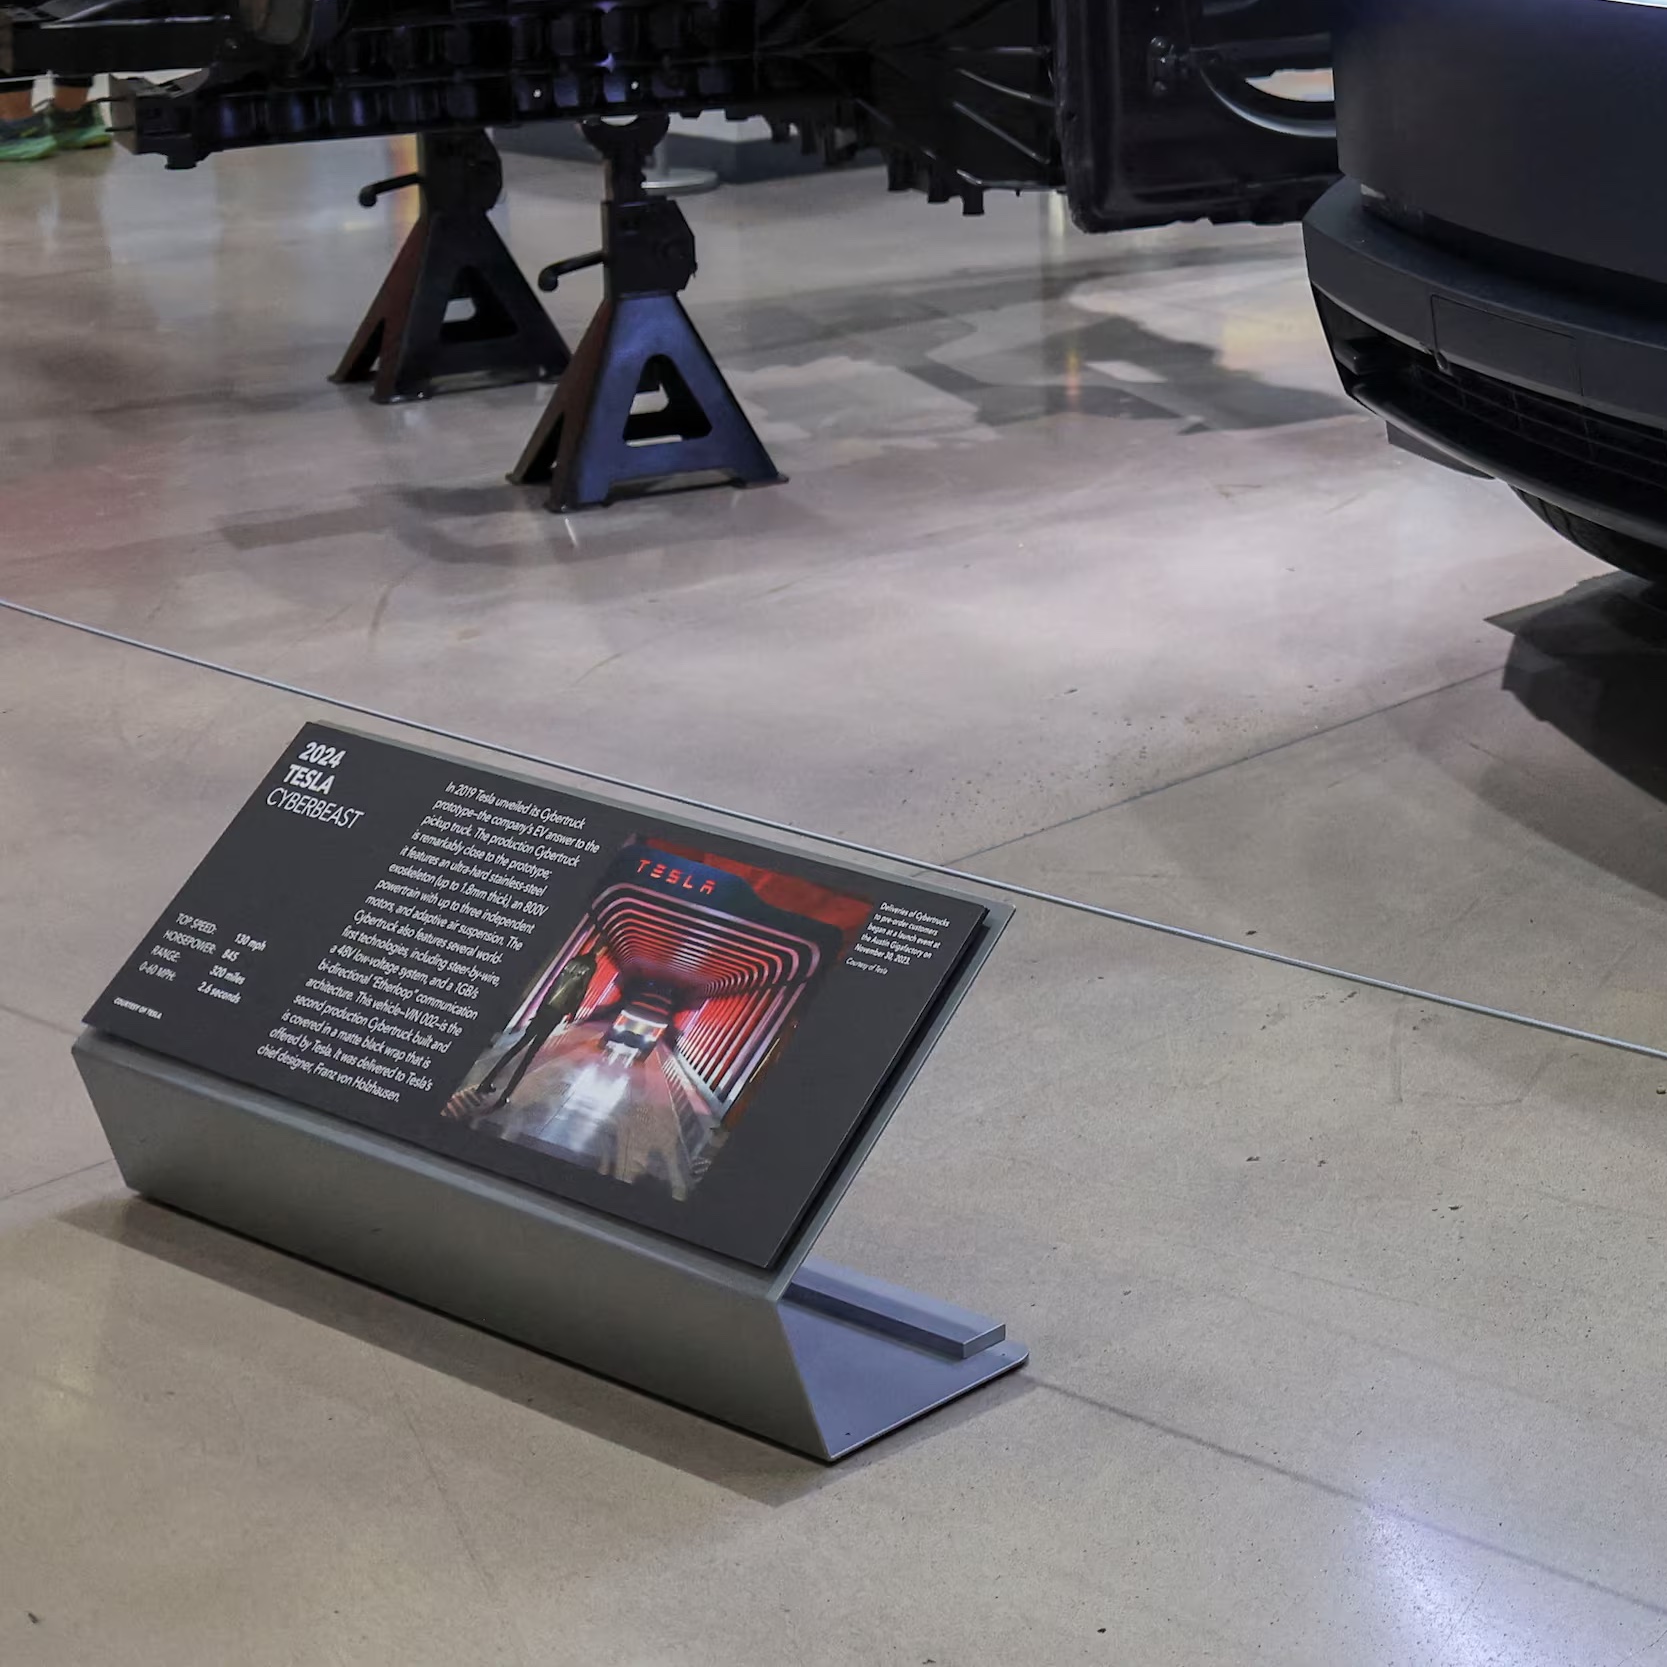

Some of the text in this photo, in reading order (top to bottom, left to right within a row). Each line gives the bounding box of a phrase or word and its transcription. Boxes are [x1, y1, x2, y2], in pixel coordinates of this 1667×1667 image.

[283, 764, 335, 795] TESLA
[298, 741, 346, 769] 2024
[267, 787, 365, 829] CYBERBEAST
[445, 781, 586, 830] In 2019 Tesla unveiled its Cybertruck
[411, 829, 553, 880] is remarkably close to the prototype;
[420, 814, 580, 867] pickup truck. The production Cybertruck
[532, 825, 550, 838] EV
[545, 831, 577, 846] answer
[574, 838, 585, 849] to
[584, 839, 600, 853] the
[388, 864, 549, 917] exoskeleton (up to 1.8mm thick), an 800V
[399, 845, 548, 897] it features an ultra-hard stainless-steel
[636, 859, 716, 895] TESLA
[365, 896, 523, 951] motors, and adaptive air suspension. The
[374, 879, 535, 934] powertrain with up to three independent
[341, 925, 500, 987] first technologies, including steer-by-wire,
[354, 909, 504, 964] Cybertruck also features several world-
[317, 958, 374, 985] bi-directional
[415, 993, 478, 1020] communication
[329, 944, 479, 999] a 48V low-voltage system, and a 1GB/s
[293, 995, 452, 1053] second production Cybertruck built and
[305, 978, 354, 1001] architecture.
[355, 991, 373, 1007] This
[446, 1022, 463, 1036] the
[269, 1026, 303, 1045] offered
[298, 1035, 312, 1052] by
[311, 1039, 332, 1057] Tesla.
[333, 1047, 342, 1060] It
[340, 1053, 358, 1065] was
[356, 1056, 399, 1078] delivered
[394, 1070, 406, 1082] to
[281, 1009, 431, 1069] is covered in a matte black wrap that is
[257, 1044, 400, 1103] chief designer, Franz von Holzhausen.
